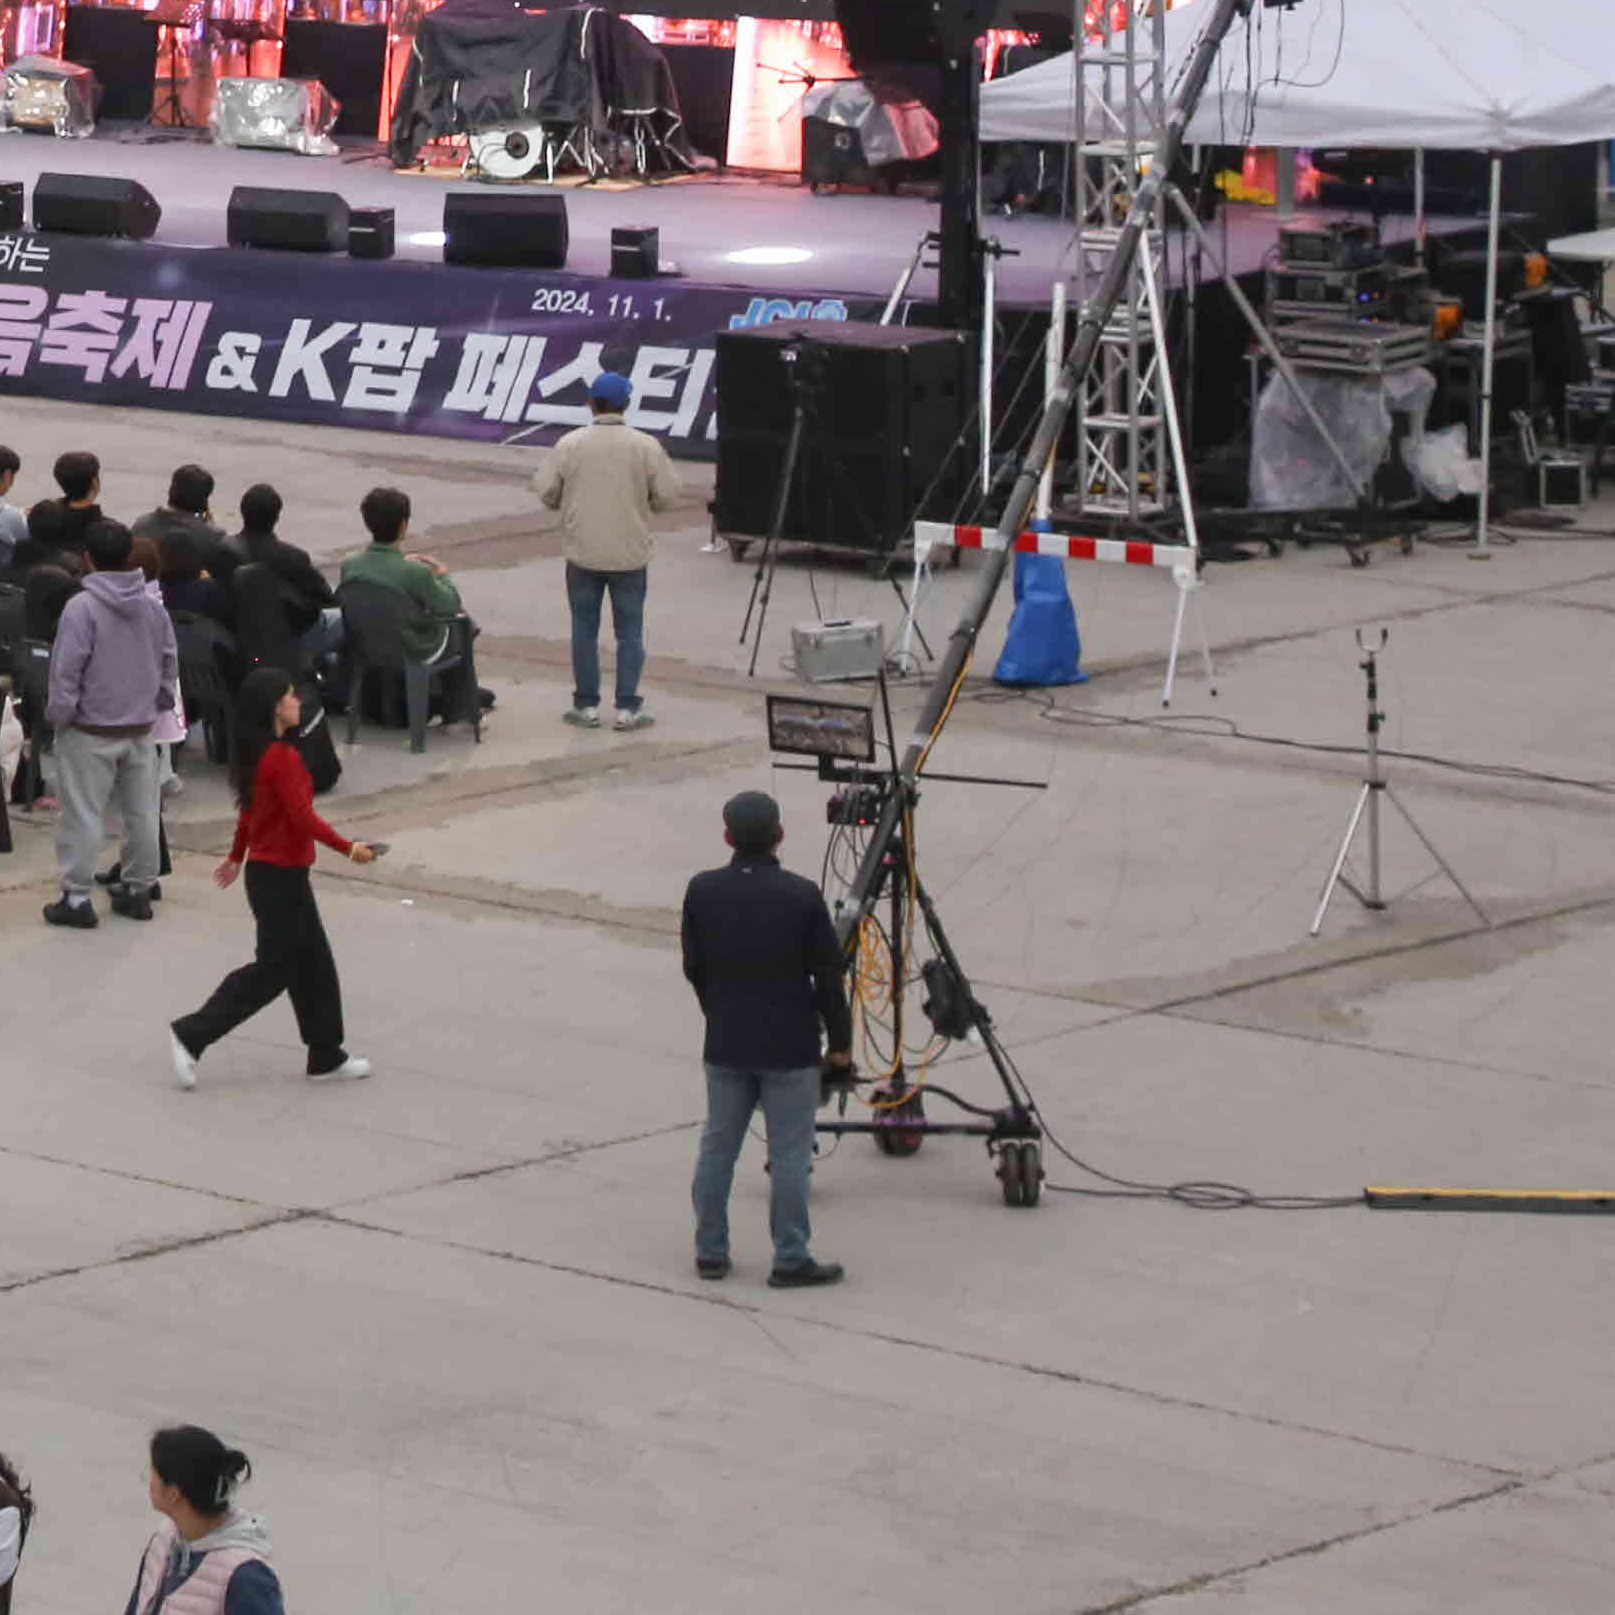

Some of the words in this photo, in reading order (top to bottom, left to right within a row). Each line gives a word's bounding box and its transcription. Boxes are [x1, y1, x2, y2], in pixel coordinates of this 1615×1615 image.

[532, 288, 595, 317] 2024.
[608, 294, 640, 320] 11.
[654, 298, 672, 322] 1.
[205, 330, 264, 392] &
[268, 318, 441, 414] K팝
[442, 331, 718, 440] 페스티
